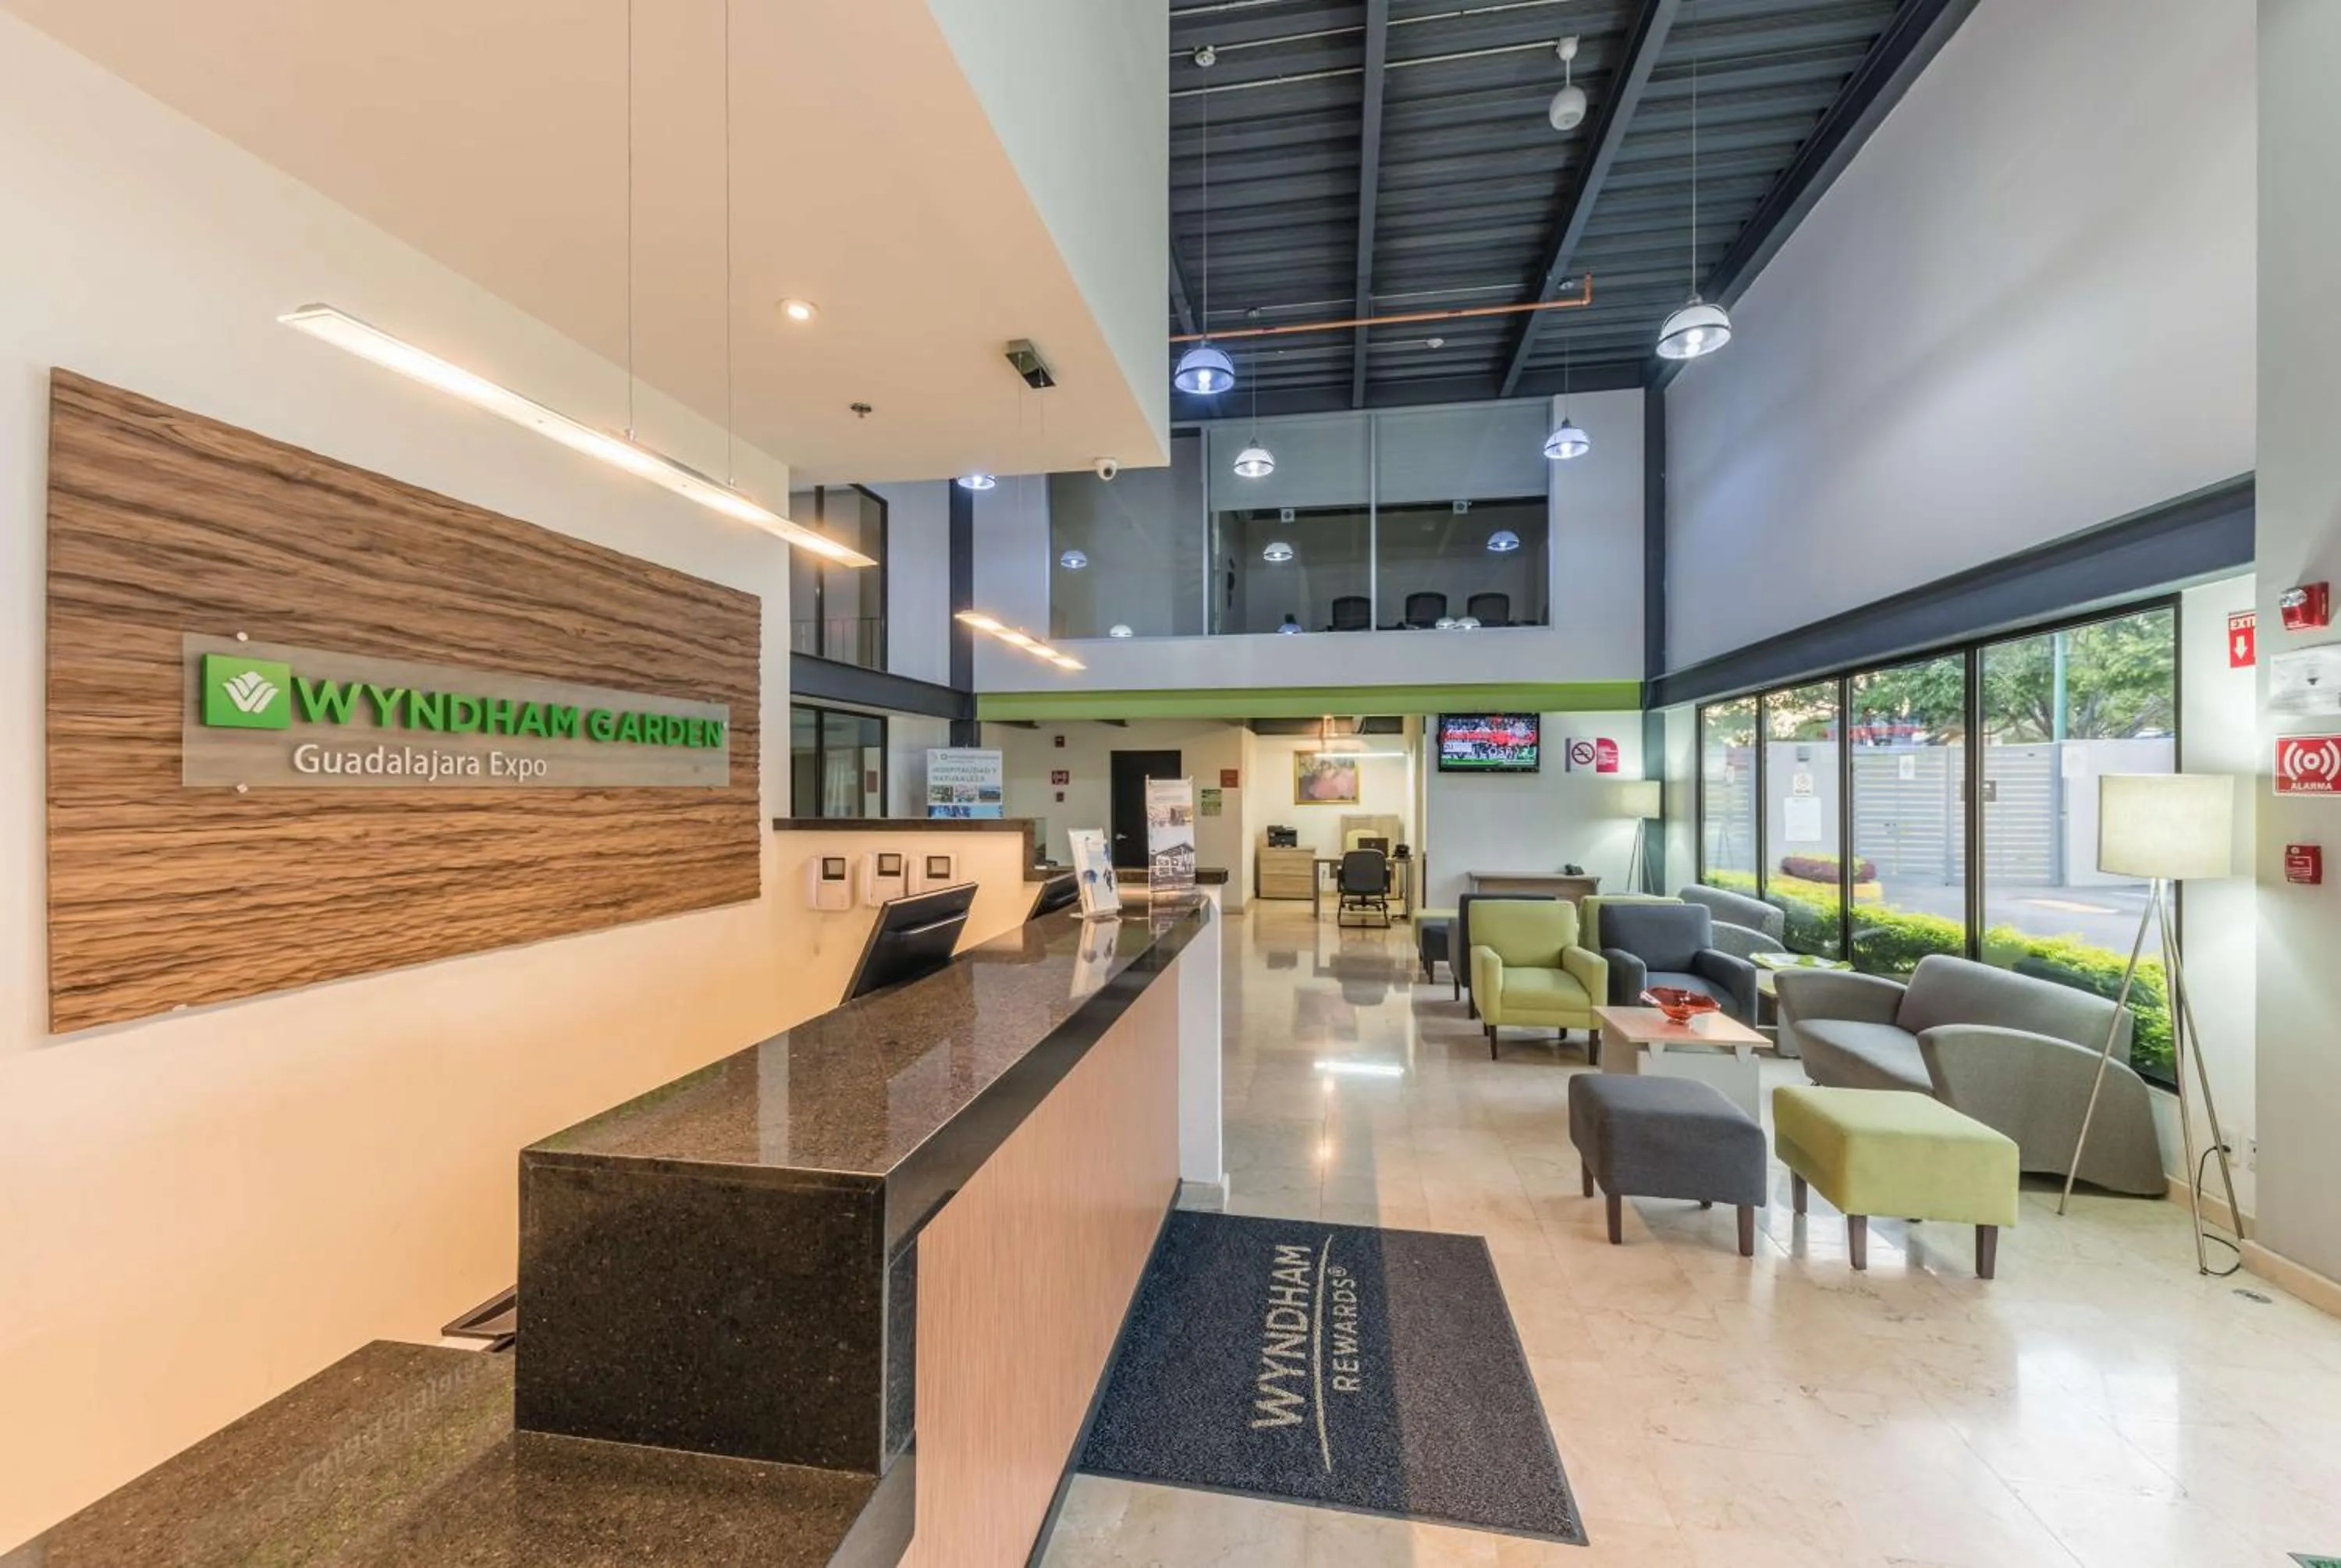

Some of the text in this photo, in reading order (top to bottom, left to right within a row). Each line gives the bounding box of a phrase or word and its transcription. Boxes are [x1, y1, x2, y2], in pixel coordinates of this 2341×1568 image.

[291, 676, 723, 747] WYNDHAM GARDEN
[293, 743, 547, 782] Guadalajara Expo
[2290, 782, 2333, 791] ALARMA
[1249, 1244, 1312, 1429] WYNDHAM
